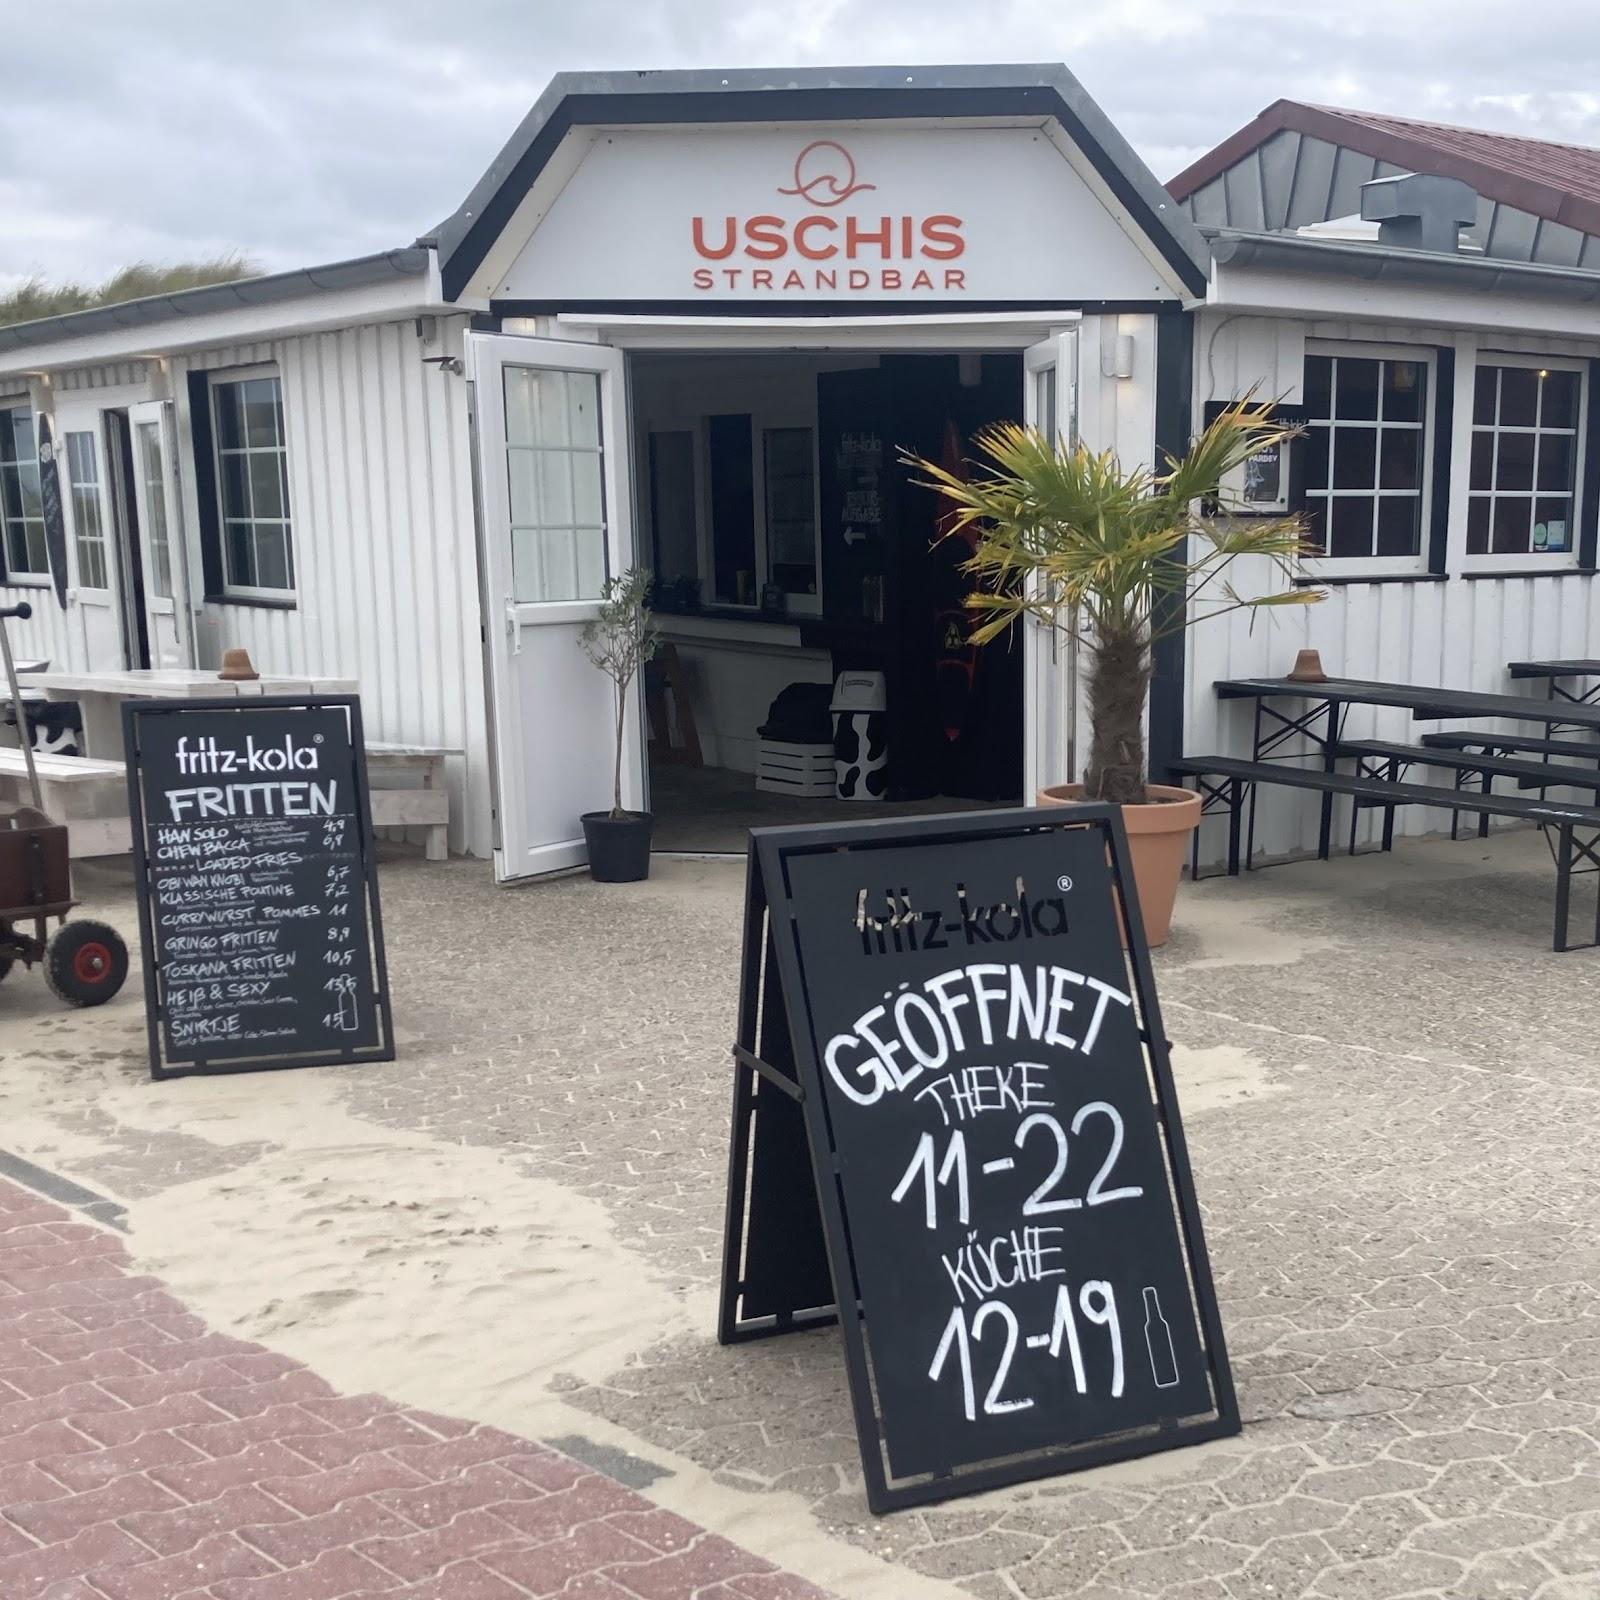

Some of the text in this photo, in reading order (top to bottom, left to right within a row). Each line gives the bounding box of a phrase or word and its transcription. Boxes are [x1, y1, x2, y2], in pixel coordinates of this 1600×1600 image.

[692, 215, 965, 260] USCHIS
[693, 269, 966, 290] STRANDBAR
[175, 734, 318, 774] fritz-kola
[164, 779, 337, 822] FRITTEN
[157, 828, 191, 844] HAN
[194, 828, 229, 841] SOLO
[203, 837, 250, 856] BACCA
[196, 852, 303, 871] LOADED FRIES
[157, 877, 182, 889] OBI
[184, 875, 209, 888] WAN
[327, 865, 351, 881] 6,7
[160, 887, 238, 905] KLASSISCHE
[240, 884, 294, 898] POUTINE
[324, 882, 349, 898] 7,2
[161, 907, 255, 926] CURRYWURST
[262, 904, 321, 919] POMMES
[328, 904, 348, 916] 11
[853, 876, 1069, 955] fritz-kola
[165, 927, 350, 952] GRINGO FRITTEN 8,9
[162, 960, 228, 979] TOSKANA
[230, 951, 296, 971] FRITTEN
[323, 949, 356, 966] 10,5
[210, 984, 222, 1000] &
[227, 981, 270, 997] SEXY
[171, 1014, 240, 1038] SNIRTJE
[824, 963, 1132, 1106] GEÖFFNET
[913, 1062, 1055, 1126] THEKE
[941, 1226, 1066, 1303] KÜCHE
[928, 1280, 1124, 1421] 12-19
